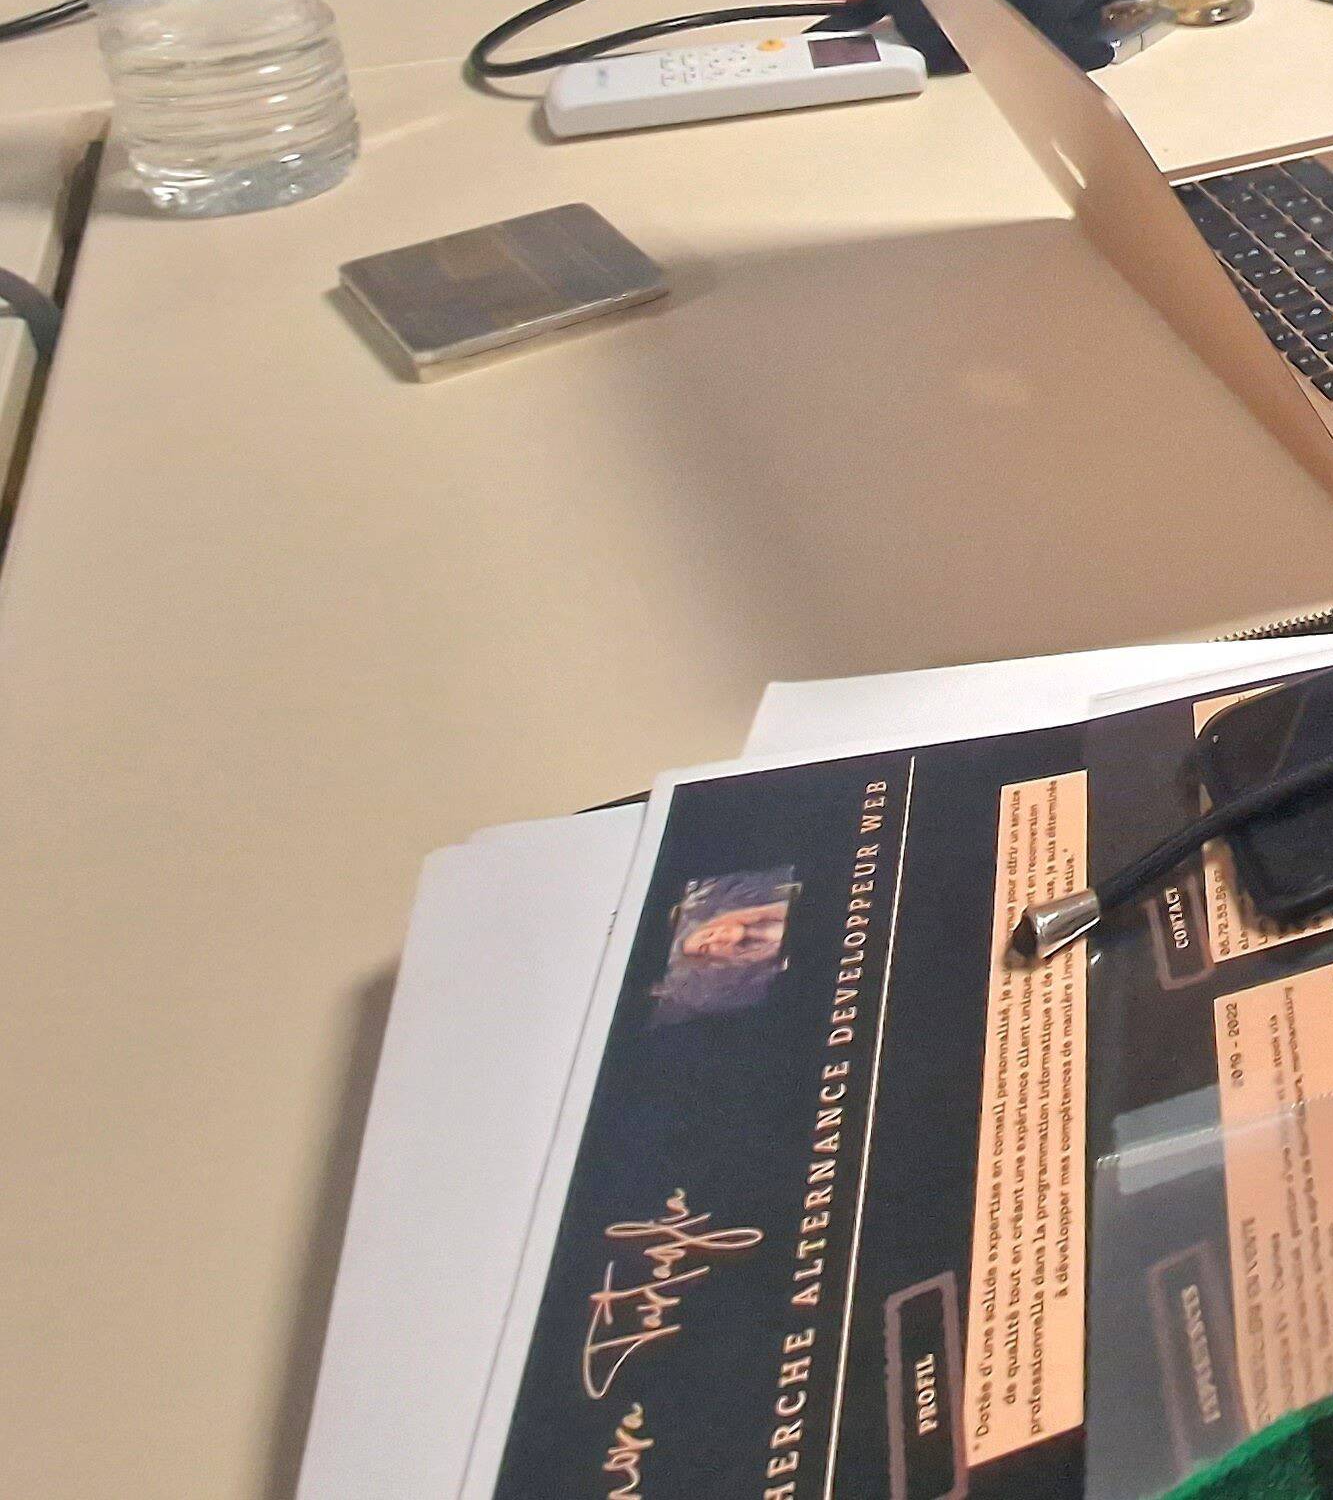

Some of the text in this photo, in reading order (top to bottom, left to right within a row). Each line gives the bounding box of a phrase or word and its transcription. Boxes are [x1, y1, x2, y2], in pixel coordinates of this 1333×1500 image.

[1009, 789, 1022, 827] service
[1043, 779, 1060, 837] déterminée
[1006, 845, 1018, 875] offrir
[1009, 829, 1019, 843] un
[1026, 803, 1040, 872] reconversion
[1044, 841, 1056, 862] suis
[1007, 877, 1018, 903] pour
[1026, 873, 1037, 888] en
[1163, 885, 1189, 949] CONTACT
[1000, 987, 1013, 1000] je
[1041, 970, 1053, 988] de
[1042, 989, 1053, 1004] et
[1059, 981, 1073, 1038] manière
[1224, 1001, 1241, 1037] 2022
[1282, 985, 1302, 1073] merchandising
[789, 1056, 851, 1307] ALTERNANCE
[827, 840, 880, 1048] DEVELOPPEUR
[859, 777, 888, 834] WEB
[993, 1002, 1014, 1099] personnalisé,
[1016, 1020, 1030, 1067] client
[1036, 1006, 1054, 1099] informatique
[1061, 1040, 1073, 1057] de
[1267, 1013, 1282, 1067] stock via
[990, 1100, 1006, 1155] conseil
[1012, 1071, 1031, 1152] expérience
[1058, 1058, 1073, 1152] compétences
[991, 1159, 1002, 1177] en
[1014, 1155, 1025, 1182] une
[1034, 1101, 1051, 1220] programmation
[1060, 1155, 1070, 1185] mes
[984, 1180, 1004, 1261] expertise
[1009, 1184, 1025, 1239] créant
[1031, 1224, 1047, 1241] la
[1055, 1190, 1071, 1282] développer
[1011, 1243, 1022, 1264] en
[1031, 1244, 1047, 1285] dans
[980, 1266, 997, 1321] solide
[1008, 1269, 1021, 1306] tout
[978, 1326, 994, 1375] d'une
[1002, 1309, 1022, 1377] qualité
[1024, 1290, 1047, 1434] professionnelle
[916, 1351, 937, 1435] PROFIL
[974, 1380, 992, 1437] Dotée
[1001, 1382, 1016, 1405] de
